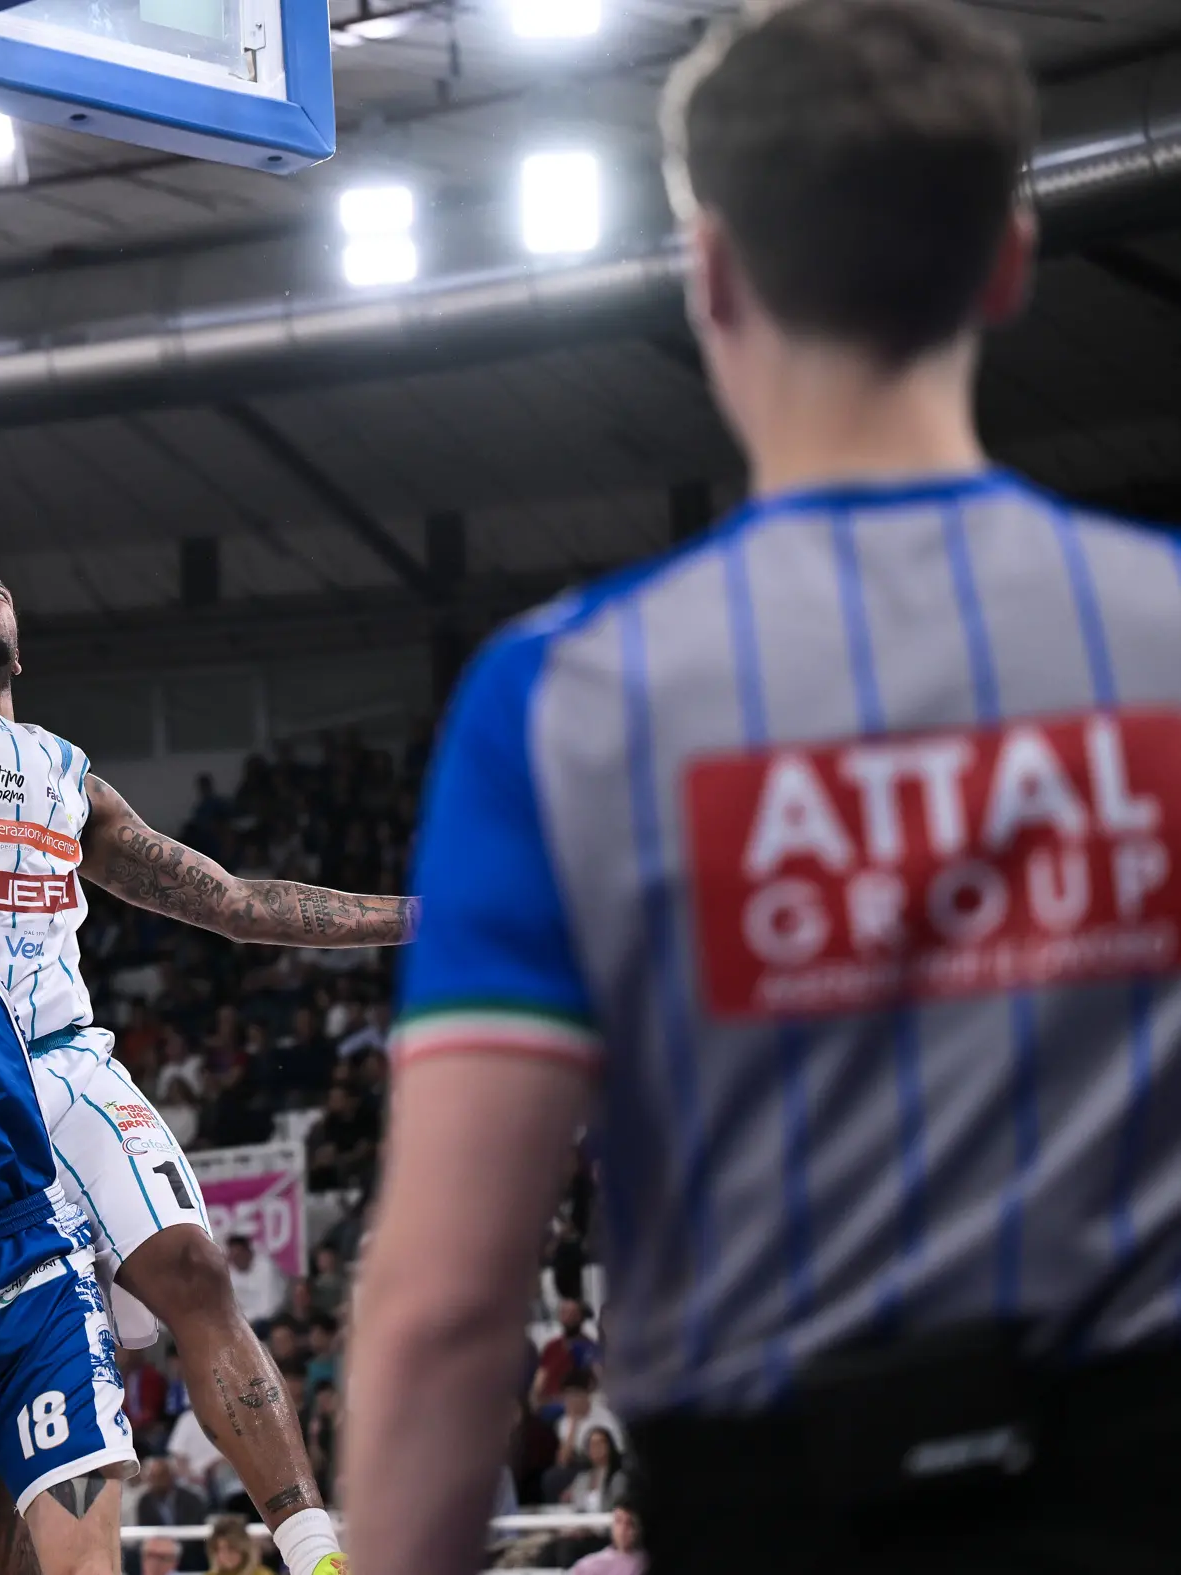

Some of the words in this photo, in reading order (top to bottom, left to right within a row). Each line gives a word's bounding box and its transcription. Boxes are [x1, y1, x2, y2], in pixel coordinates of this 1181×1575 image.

[740, 714, 1164, 879] ATTAL
[740, 836, 1172, 967] GROUP
[17, 1390, 69, 1460] 18
